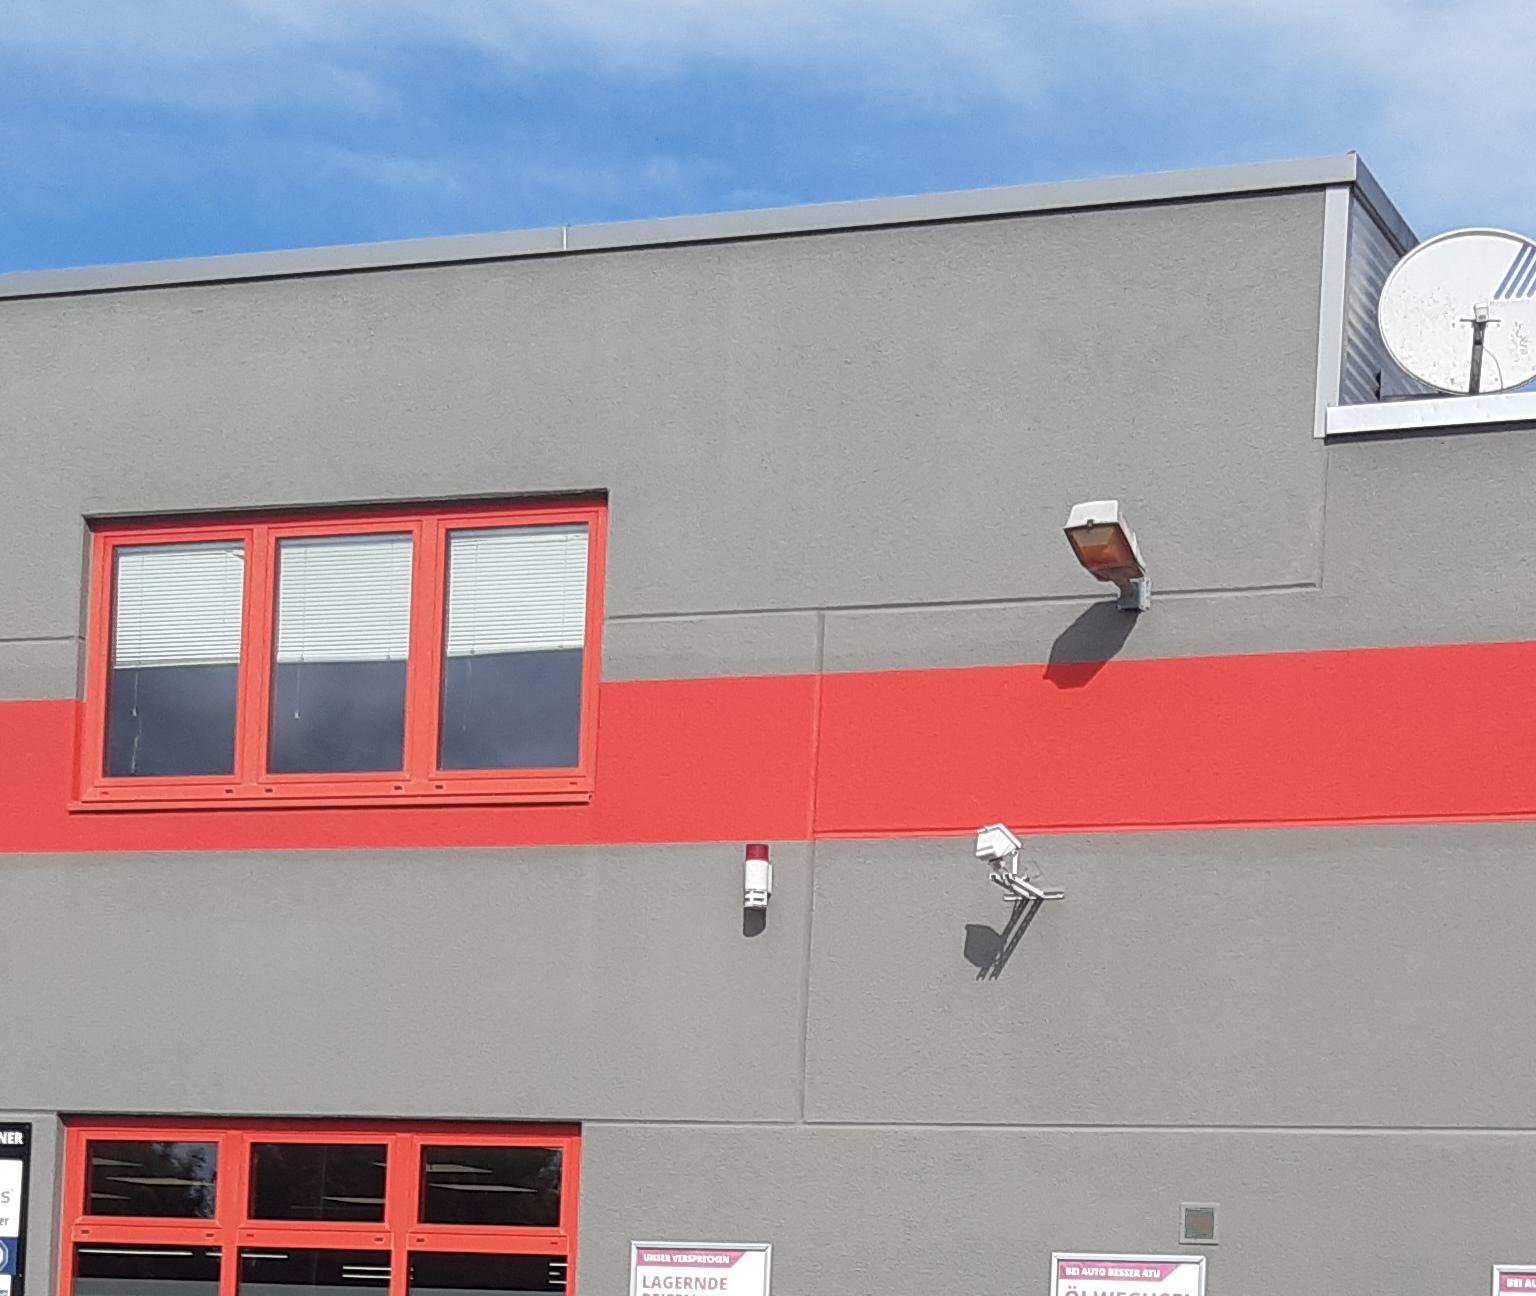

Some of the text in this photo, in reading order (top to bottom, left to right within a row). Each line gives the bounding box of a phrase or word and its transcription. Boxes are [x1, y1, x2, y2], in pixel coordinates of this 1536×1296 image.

[1065, 1266, 1161, 1278] BEI AUTO BESSER ATU
[642, 1275, 728, 1290] LAGERNDE
[1506, 1278, 1522, 1288] BEI
